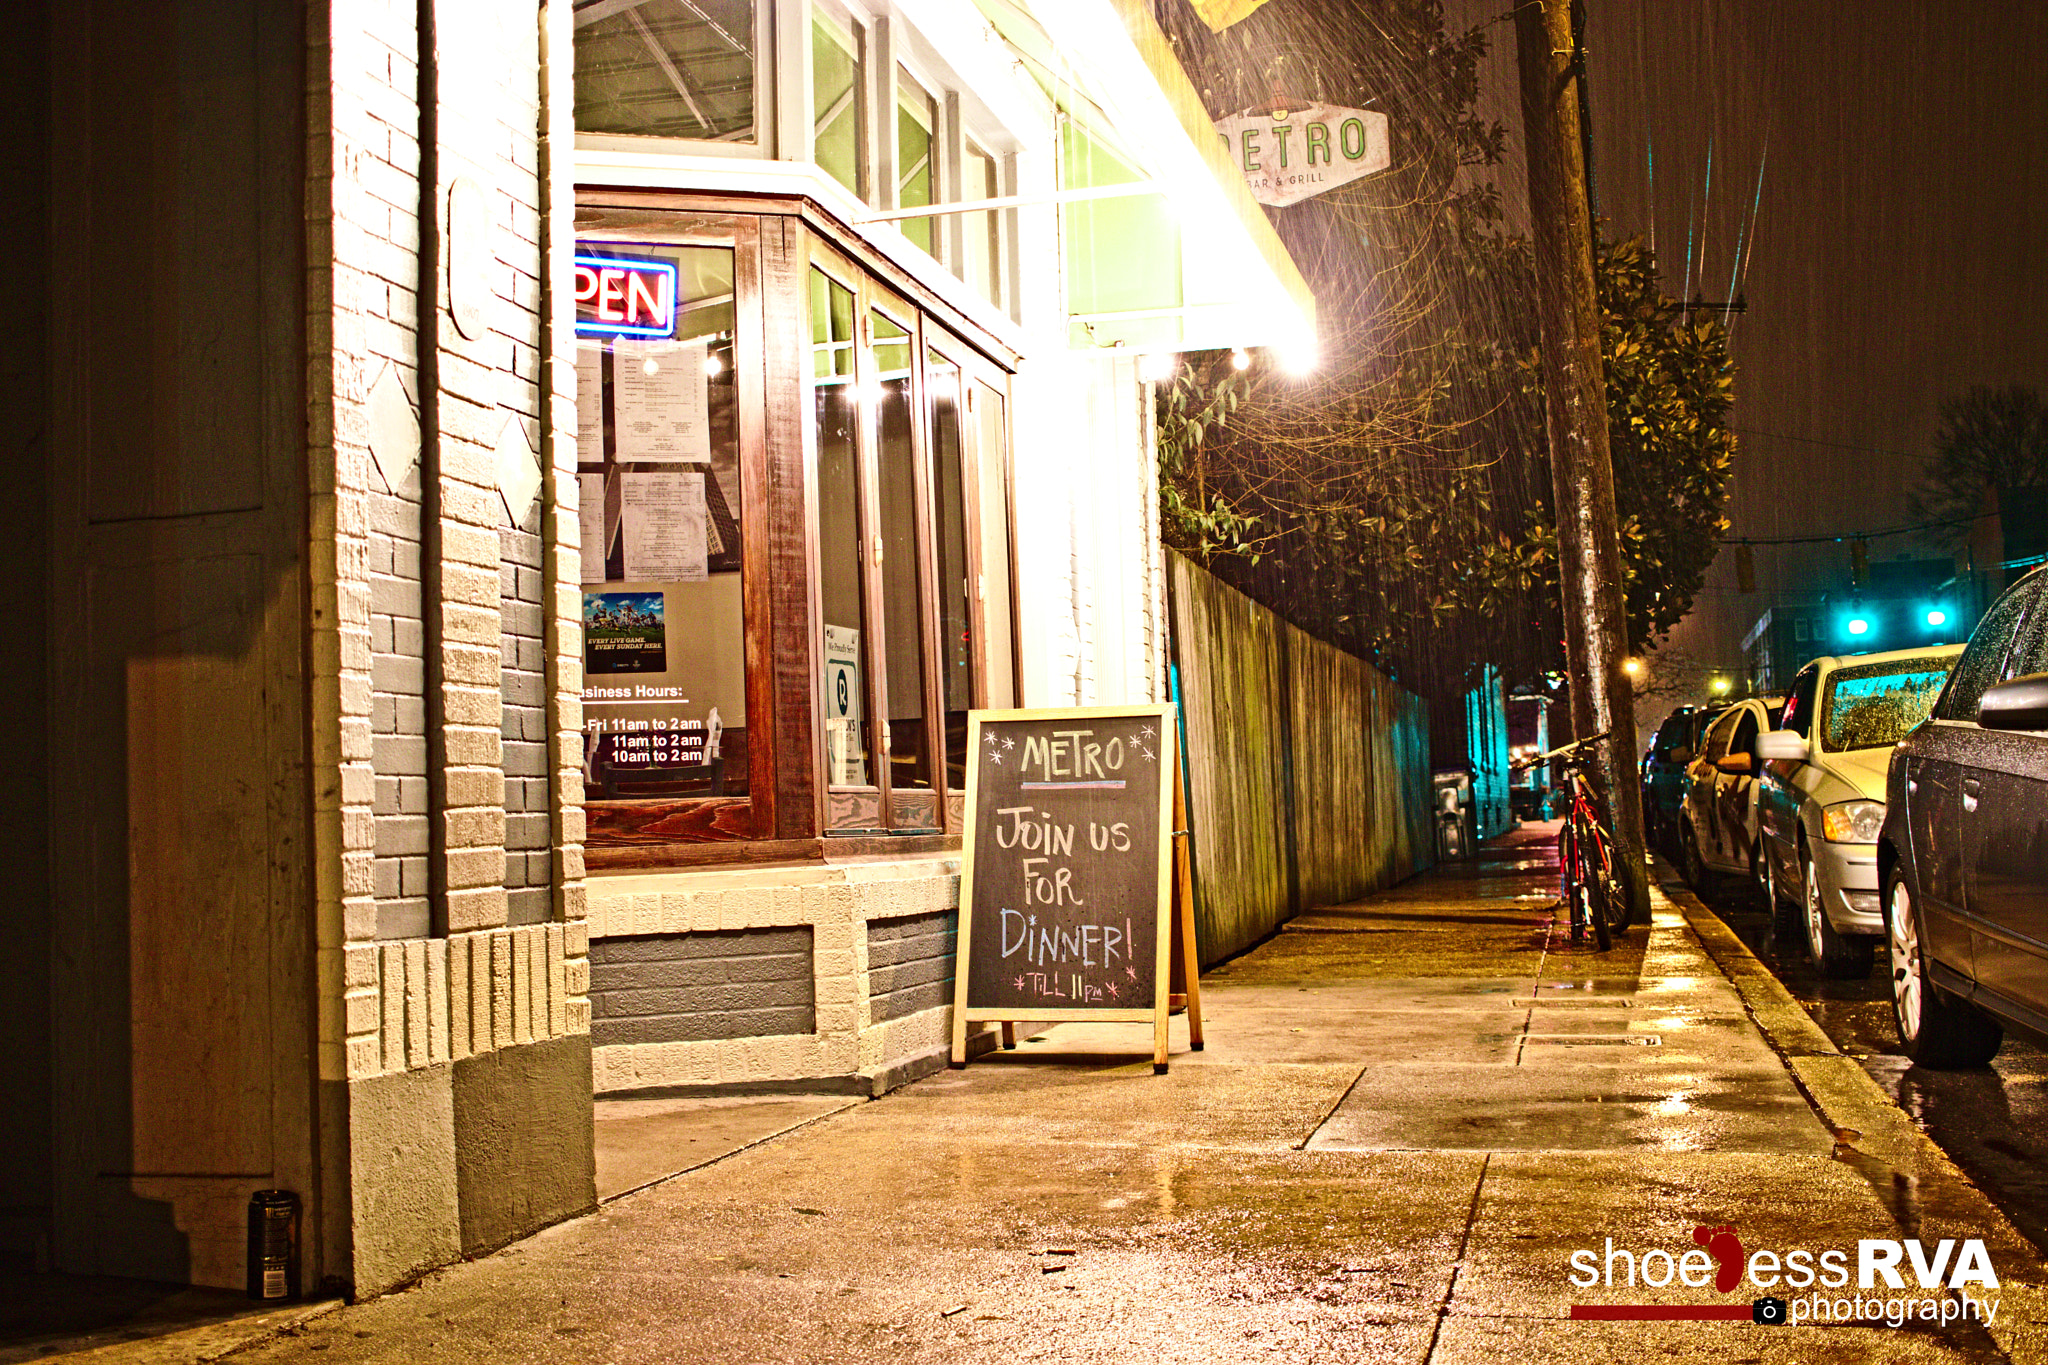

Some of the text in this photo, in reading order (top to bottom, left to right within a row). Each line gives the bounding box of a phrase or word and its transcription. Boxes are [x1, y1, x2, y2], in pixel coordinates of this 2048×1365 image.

[1219, 117, 1366, 171] ETRO
[1275, 176, 1283, 186] &
[1289, 172, 1325, 185] GRILL
[462, 303, 480, 322] 1907
[635, 684, 683, 697] Hours:
[612, 718, 651, 730] 11am
[652, 718, 667, 730] to
[612, 735, 649, 747] 11am
[652, 734, 668, 747] to
[612, 750, 651, 763] 10am
[652, 750, 668, 762] to
[1020, 730, 1125, 782] METRO
[1022, 857, 1084, 906] FOR
